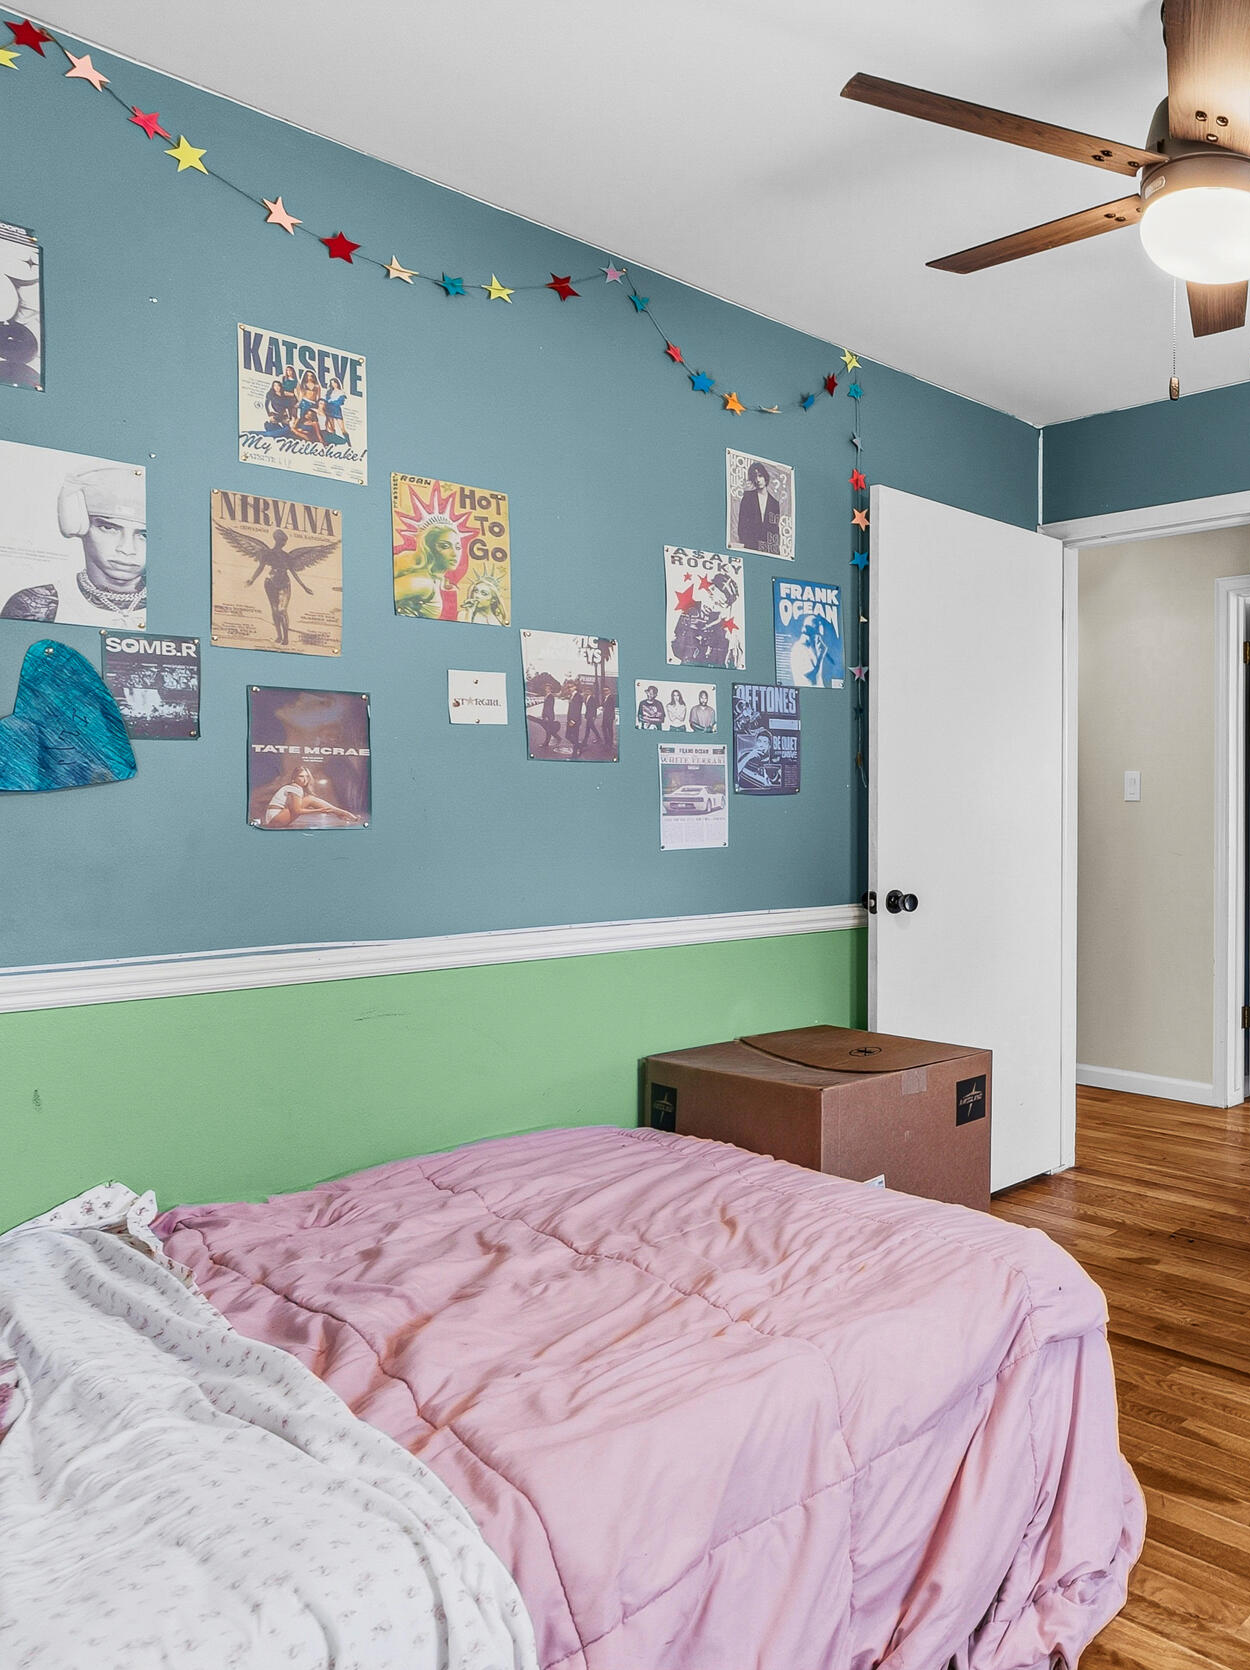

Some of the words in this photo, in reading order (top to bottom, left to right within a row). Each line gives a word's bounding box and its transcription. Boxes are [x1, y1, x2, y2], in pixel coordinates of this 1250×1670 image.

[243, 330, 362, 397] KATSEYE
[239, 434, 272, 454] My
[276, 439, 367, 461] Milkshake!
[400, 475, 431, 486] ROAN
[220, 491, 335, 536] NIRVANA
[671, 555, 742, 575] ROCKY
[779, 582, 839, 605] FRANK
[779, 598, 839, 640] OCEAN
[735, 685, 796, 713] DEFTONES
[252, 744, 301, 754] TATE
[304, 746, 370, 757] MCRAE
